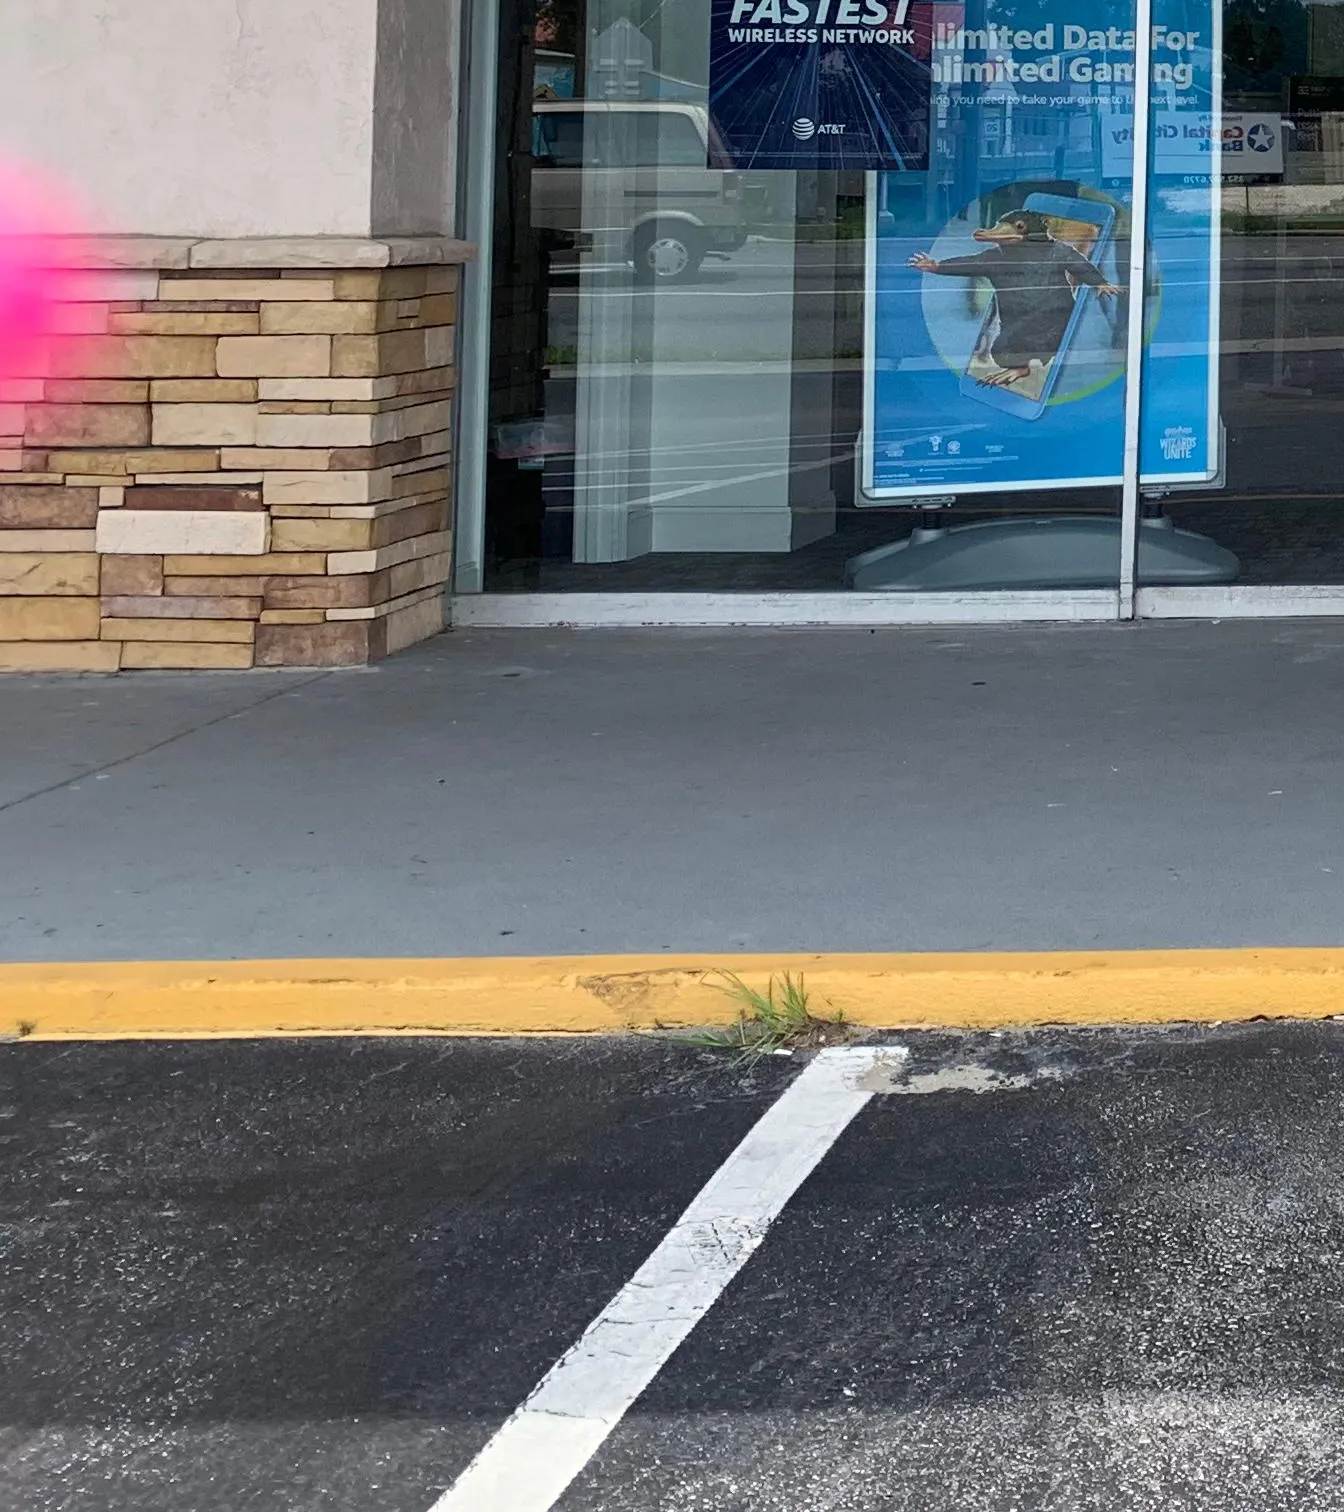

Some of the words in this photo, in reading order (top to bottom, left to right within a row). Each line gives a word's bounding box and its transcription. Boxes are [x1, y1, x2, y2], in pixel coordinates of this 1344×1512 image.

[728, 28, 818, 43] WIRELESS
[822, 29, 915, 45] NETWORK
[932, 22, 1053, 50] limited
[1063, 25, 1136, 50] Data
[1151, 25, 1200, 51] For
[1069, 57, 1193, 89] Gamng
[953, 96, 974, 106] you
[977, 94, 1005, 104] need
[1022, 94, 1047, 104] take
[1049, 96, 1077, 107] your
[817, 124, 846, 134] AT&T
[1164, 448, 1193, 460] UNITE
